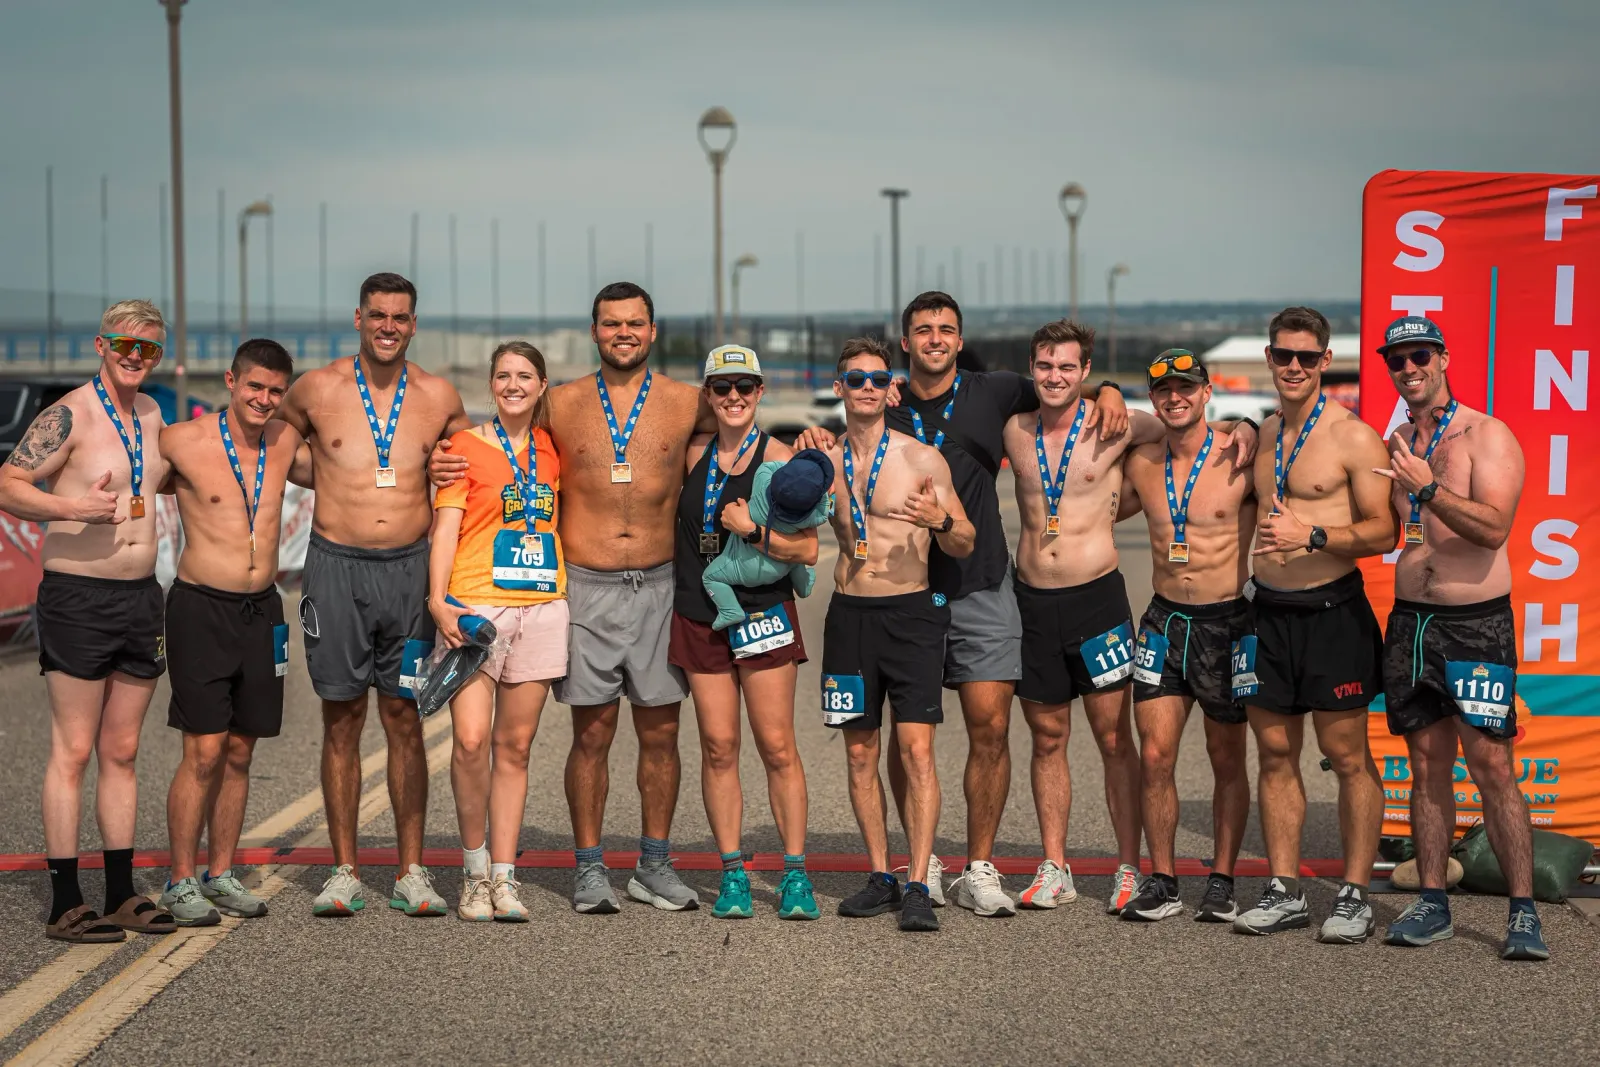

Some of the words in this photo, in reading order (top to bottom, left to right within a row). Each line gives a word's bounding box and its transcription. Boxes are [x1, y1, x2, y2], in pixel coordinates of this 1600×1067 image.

[1404, 322, 1425, 331] RUT
[1523, 185, 1598, 662] FINISH
[510, 546, 545, 567] 709
[536, 582, 550, 591] 709
[736, 615, 785, 643] 1068
[1236, 686, 1252, 697] 1174
[1333, 682, 1363, 699] VMI
[1454, 678, 1504, 702] 1110
[1484, 717, 1502, 728] 1110
